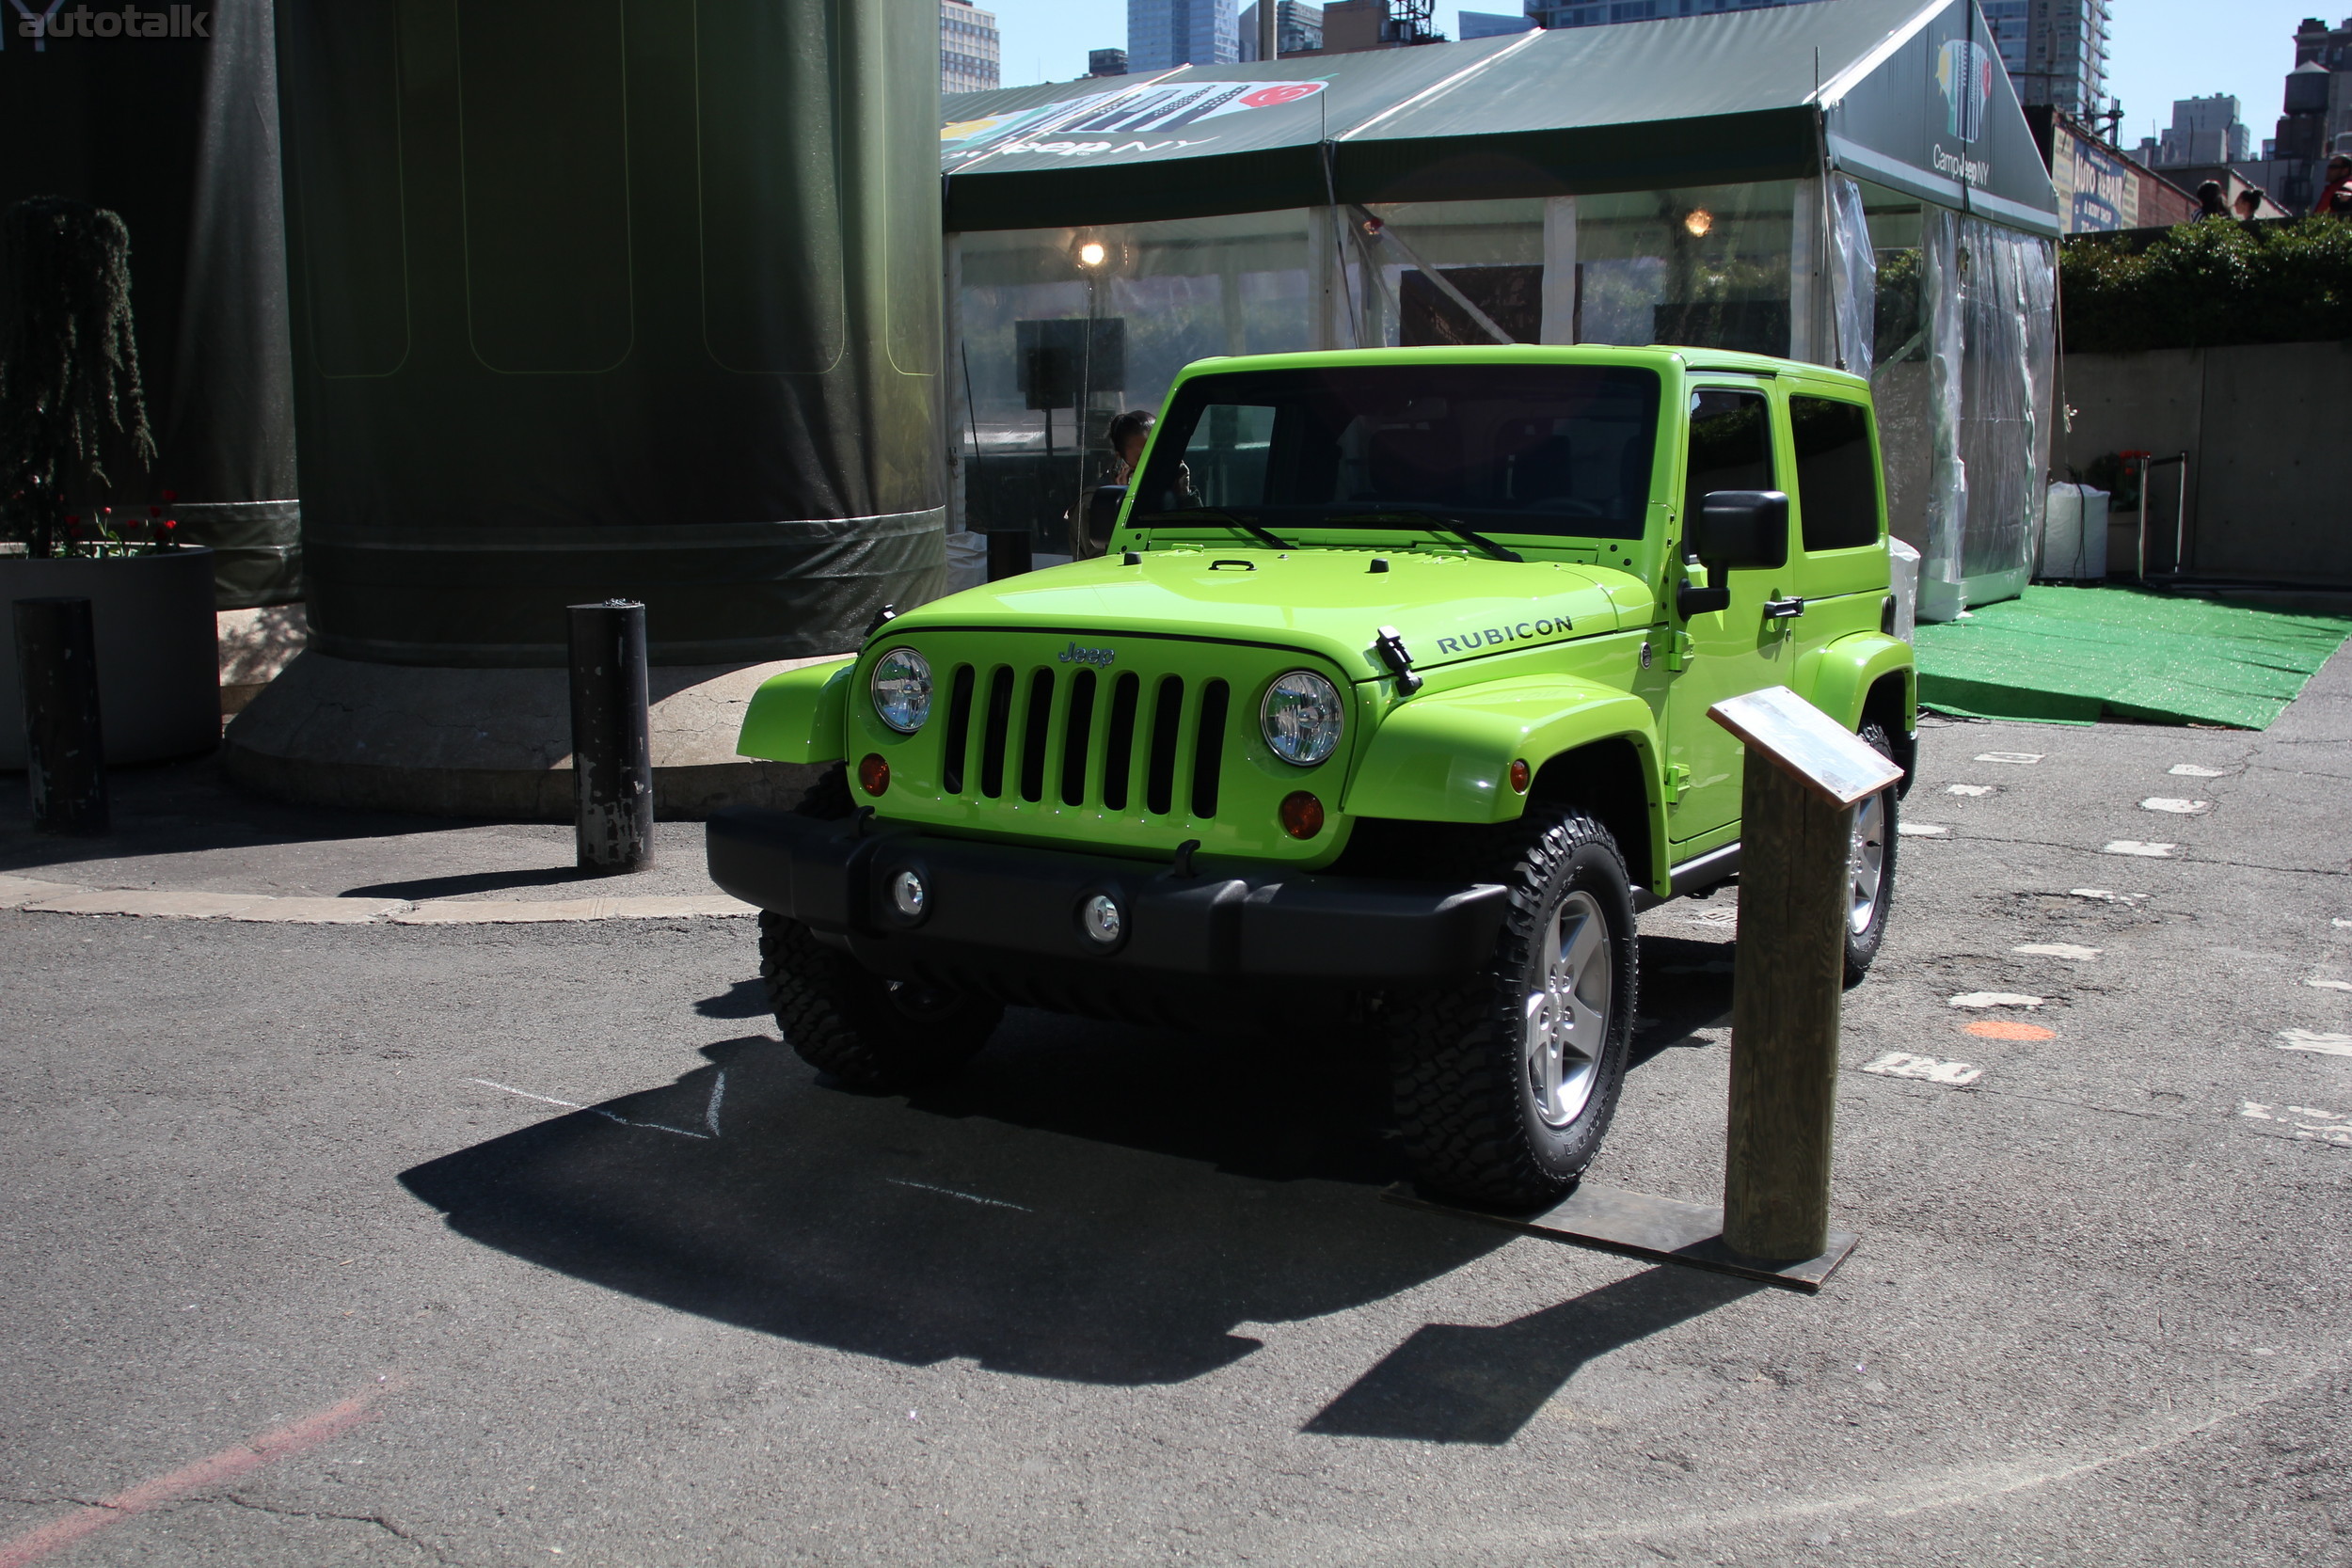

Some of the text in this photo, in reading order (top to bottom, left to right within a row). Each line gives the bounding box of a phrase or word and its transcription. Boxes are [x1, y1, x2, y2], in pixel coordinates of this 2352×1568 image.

[2074, 152, 2096, 194] AUTO
[2097, 170, 2122, 215] REPAIR
[1058, 641, 1115, 669] Jeep
[1437, 615, 1574, 655] RUBICON
